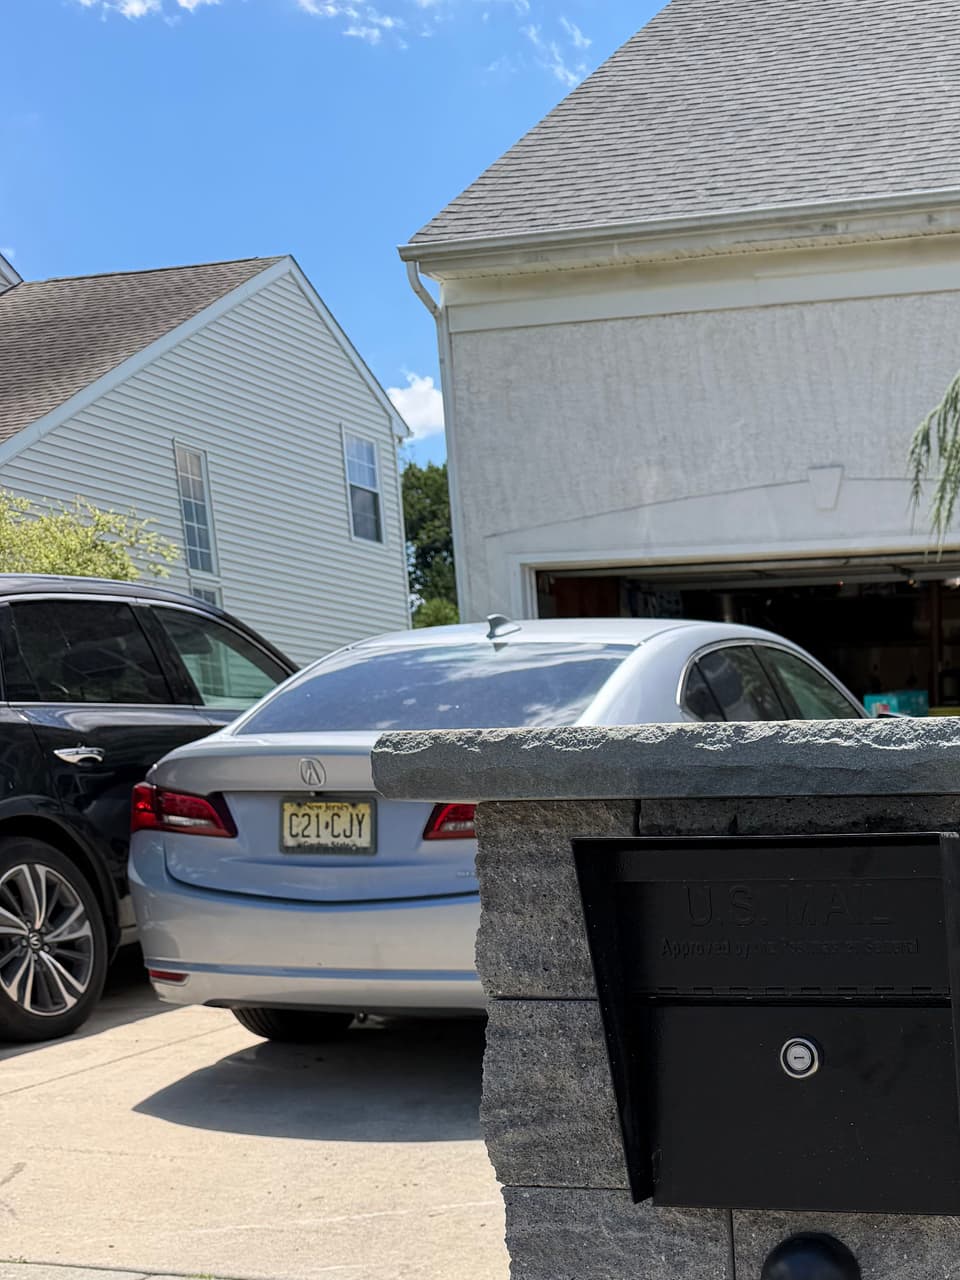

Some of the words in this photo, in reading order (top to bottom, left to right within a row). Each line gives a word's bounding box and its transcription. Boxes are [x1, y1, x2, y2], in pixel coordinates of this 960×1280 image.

[289, 812, 320, 838] C21
[331, 812, 365, 838] CJY
[680, 884, 769, 928] U.S.
[661, 936, 731, 960] Approved
[735, 937, 752, 960] by
